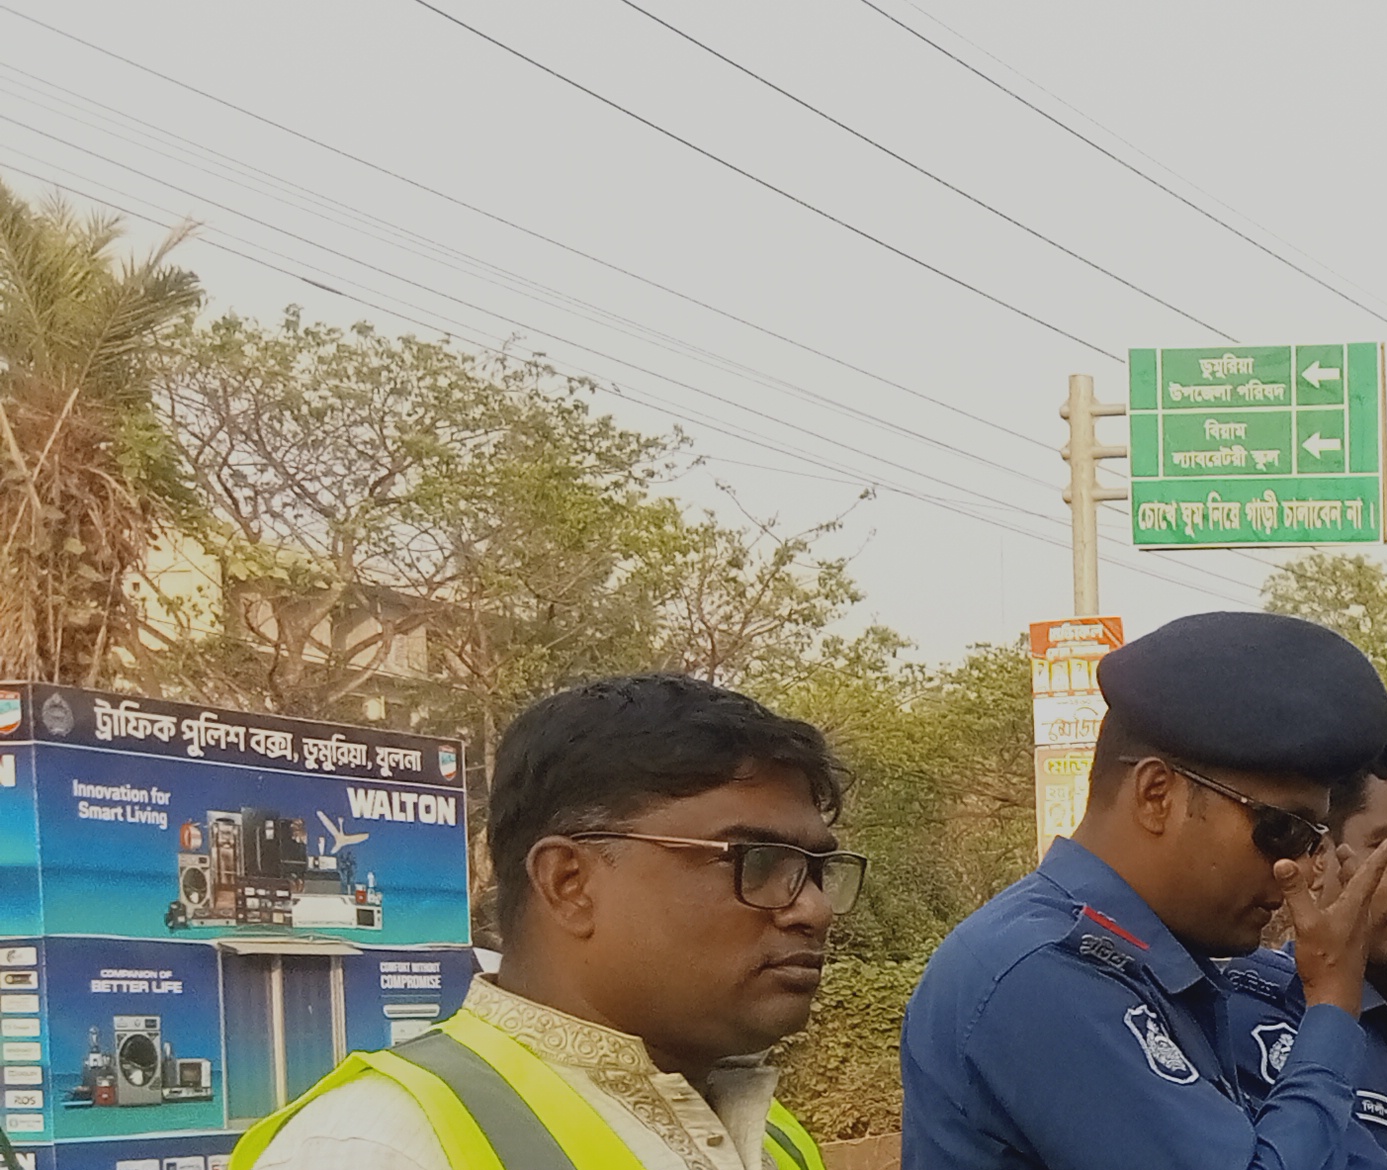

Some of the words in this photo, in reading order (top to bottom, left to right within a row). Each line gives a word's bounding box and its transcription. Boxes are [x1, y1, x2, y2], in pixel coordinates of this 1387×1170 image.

[1199, 353, 1254, 380] ডুমুরিয়া
[1168, 384, 1232, 402] উপজেলা
[1236, 379, 1286, 401] পরিষদ
[1250, 450, 1280, 471] স্কুল
[1138, 501, 1177, 531] চোখে
[1181, 502, 1204, 538] ঘুম
[1207, 491, 1241, 530] নিয়ে
[1246, 489, 1278, 534] গাড়ী
[1282, 498, 1342, 531] চালাবেন
[94, 699, 176, 742] ট্রাফিক
[181, 711, 246, 757] পুলিশ
[303, 733, 372, 771] ডুমুরিয়া,
[376, 746, 421, 776] খুলনা
[73, 779, 148, 803] Innovation
[151, 787, 170, 805] for
[79, 801, 124, 822] Smart
[126, 805, 168, 829] Living
[347, 787, 456, 826] WALTON
[91, 980, 149, 993] BETTER
[152, 981, 183, 993] LIFE
[380, 975, 441, 988] COMPROMISE
